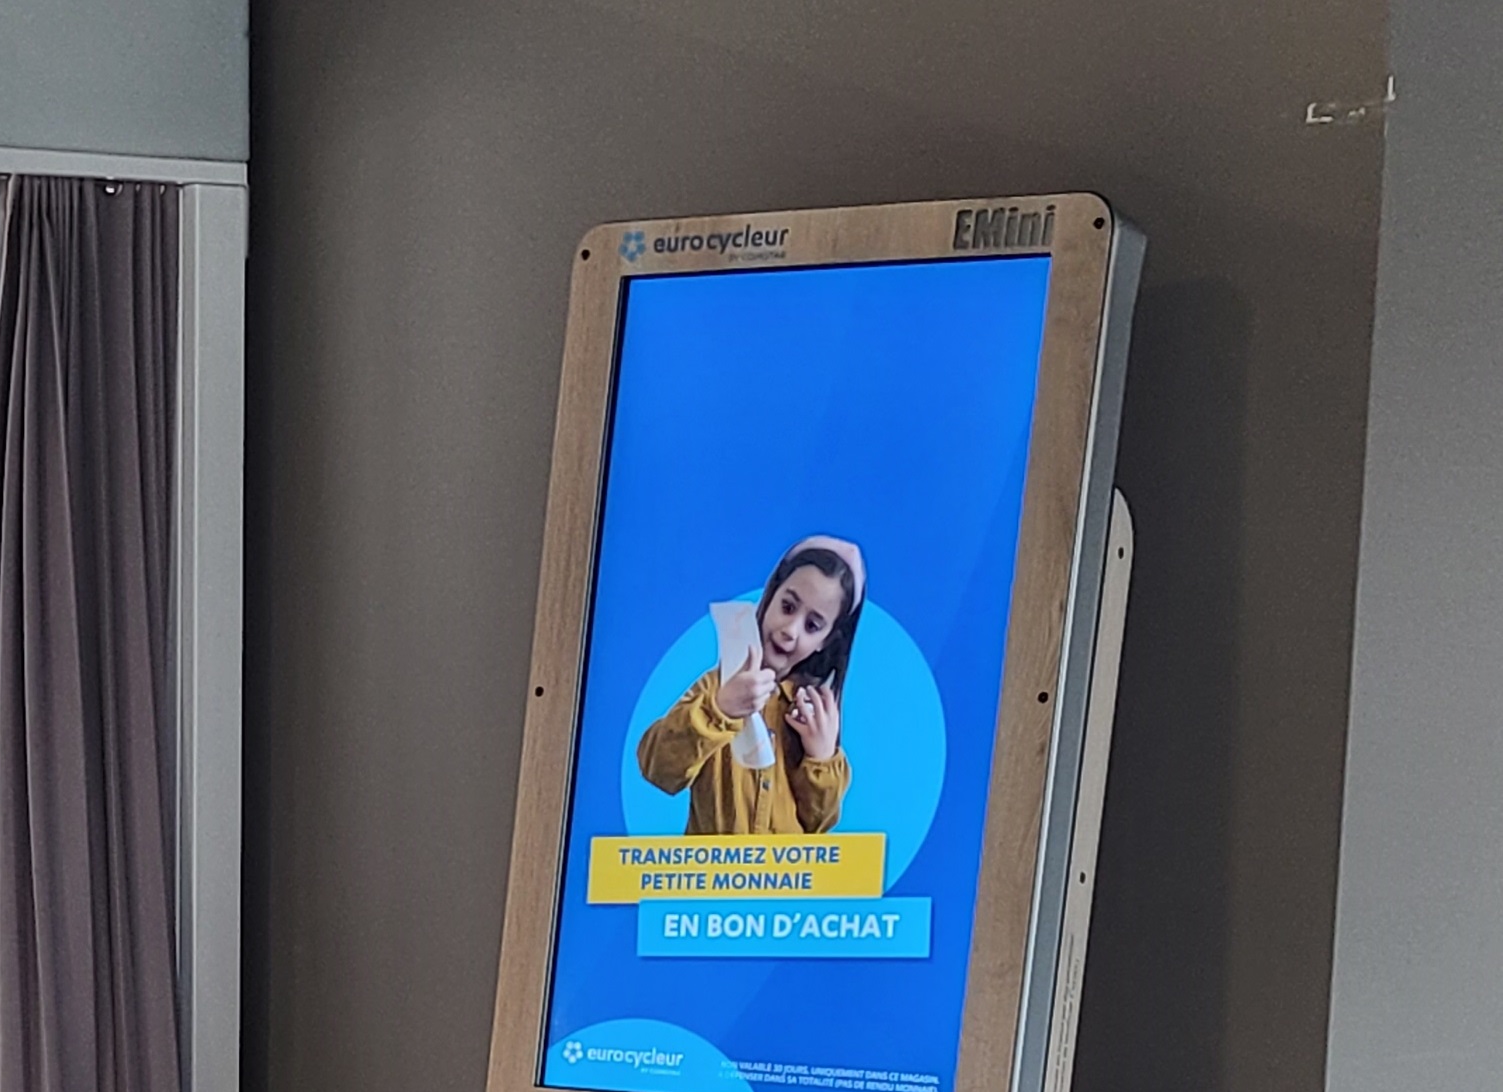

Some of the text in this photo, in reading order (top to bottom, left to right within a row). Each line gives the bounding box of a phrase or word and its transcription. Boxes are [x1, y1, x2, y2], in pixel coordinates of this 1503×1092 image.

[653, 204, 1056, 255] eurocycleur EMini
[619, 846, 840, 866] TRANSFORMEZ VOTRE
[640, 872, 813, 890] PETITE MONNAIE
[664, 912, 900, 939] EN BON D’ACHAT
[587, 1046, 684, 1069] eurocycleur
[739, 1061, 772, 1072] VALABLE
[810, 1066, 864, 1078] UNIQUEMENT
[865, 1070, 888, 1080] DANS
[888, 1072, 899, 1081] CE
[764, 1074, 786, 1083] DANS
[787, 1075, 797, 1084] SA
[798, 1075, 834, 1087] TOTALITÉ
[834, 1079, 853, 1089] (PAS
[853, 1080, 864, 1090] DE
[865, 1081, 894, 1091] RENDU
